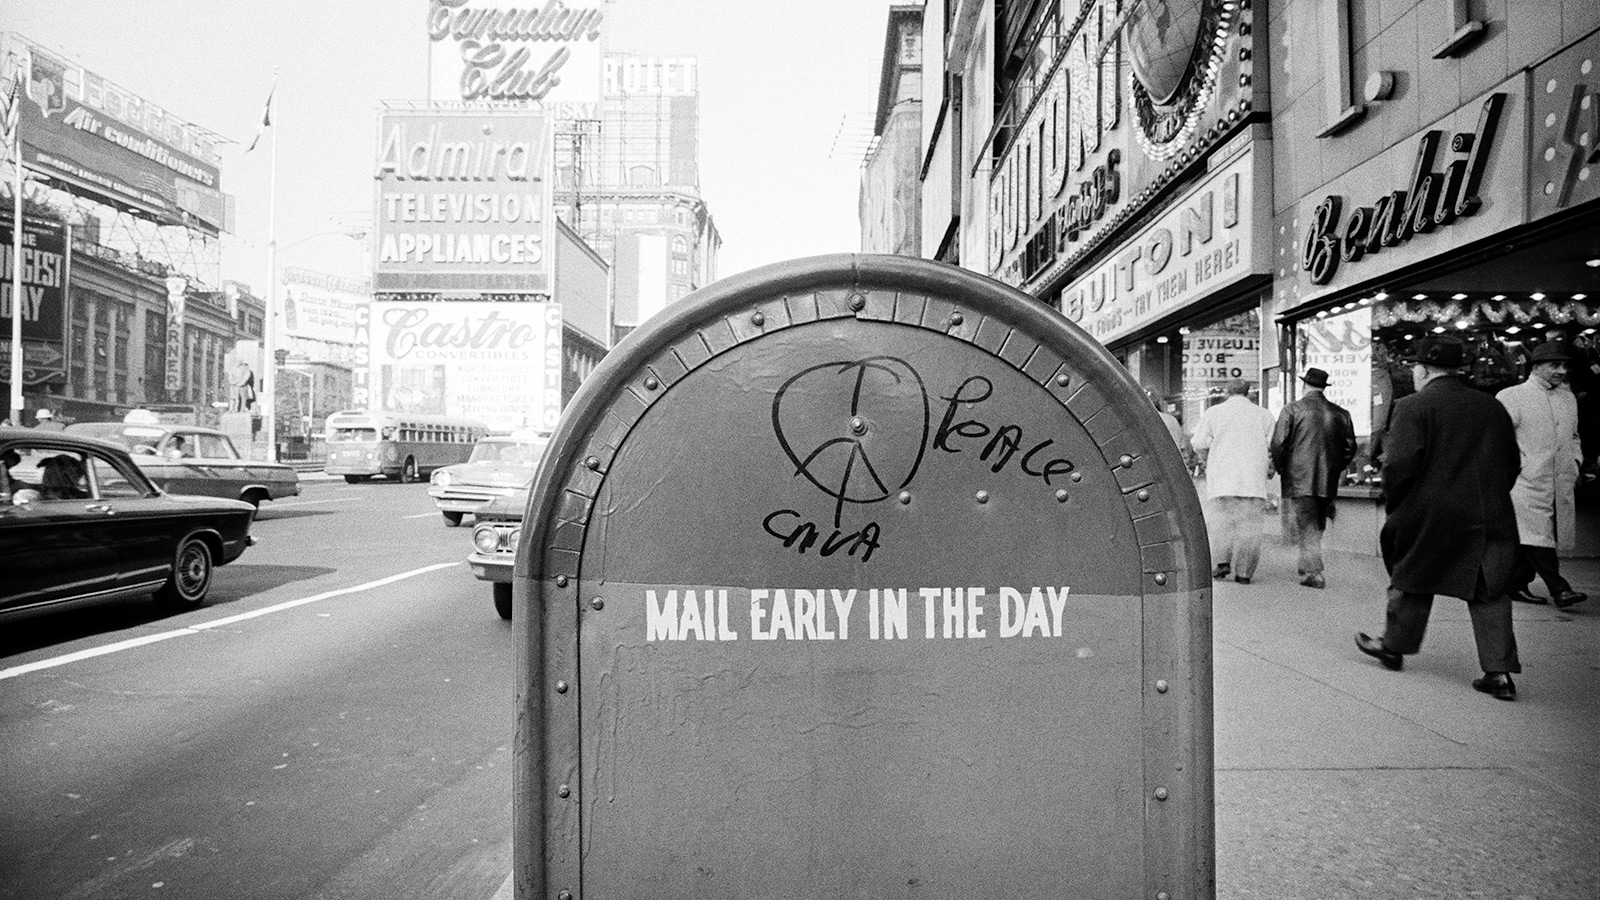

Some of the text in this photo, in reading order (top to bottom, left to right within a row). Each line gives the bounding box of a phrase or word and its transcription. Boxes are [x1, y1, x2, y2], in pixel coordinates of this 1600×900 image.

[428, 0, 603, 41] Canadian
[459, 39, 570, 100] Club
[64, 106, 103, 131] Air
[104, 125, 214, 185] conditioners
[374, 122, 549, 181] Admiral
[384, 193, 541, 222] TELEVISION
[1302, 92, 1506, 285] Benhil
[379, 233, 542, 263] APPLIANCES
[1066, 172, 1239, 323] BUITONI
[1157, 269, 1186, 304] THEM
[1195, 239, 1237, 286] HERE!
[354, 306, 370, 411] CASTR
[381, 307, 537, 360] Castro
[414, 349, 530, 360] CONVERTIBLES
[461, 374, 529, 383] CONVERTIBLE
[467, 384, 522, 393] FURNITURE
[544, 307, 561, 427] CASTRO
[646, 585, 1070, 641] MAIL EARLY IN THE DAY
